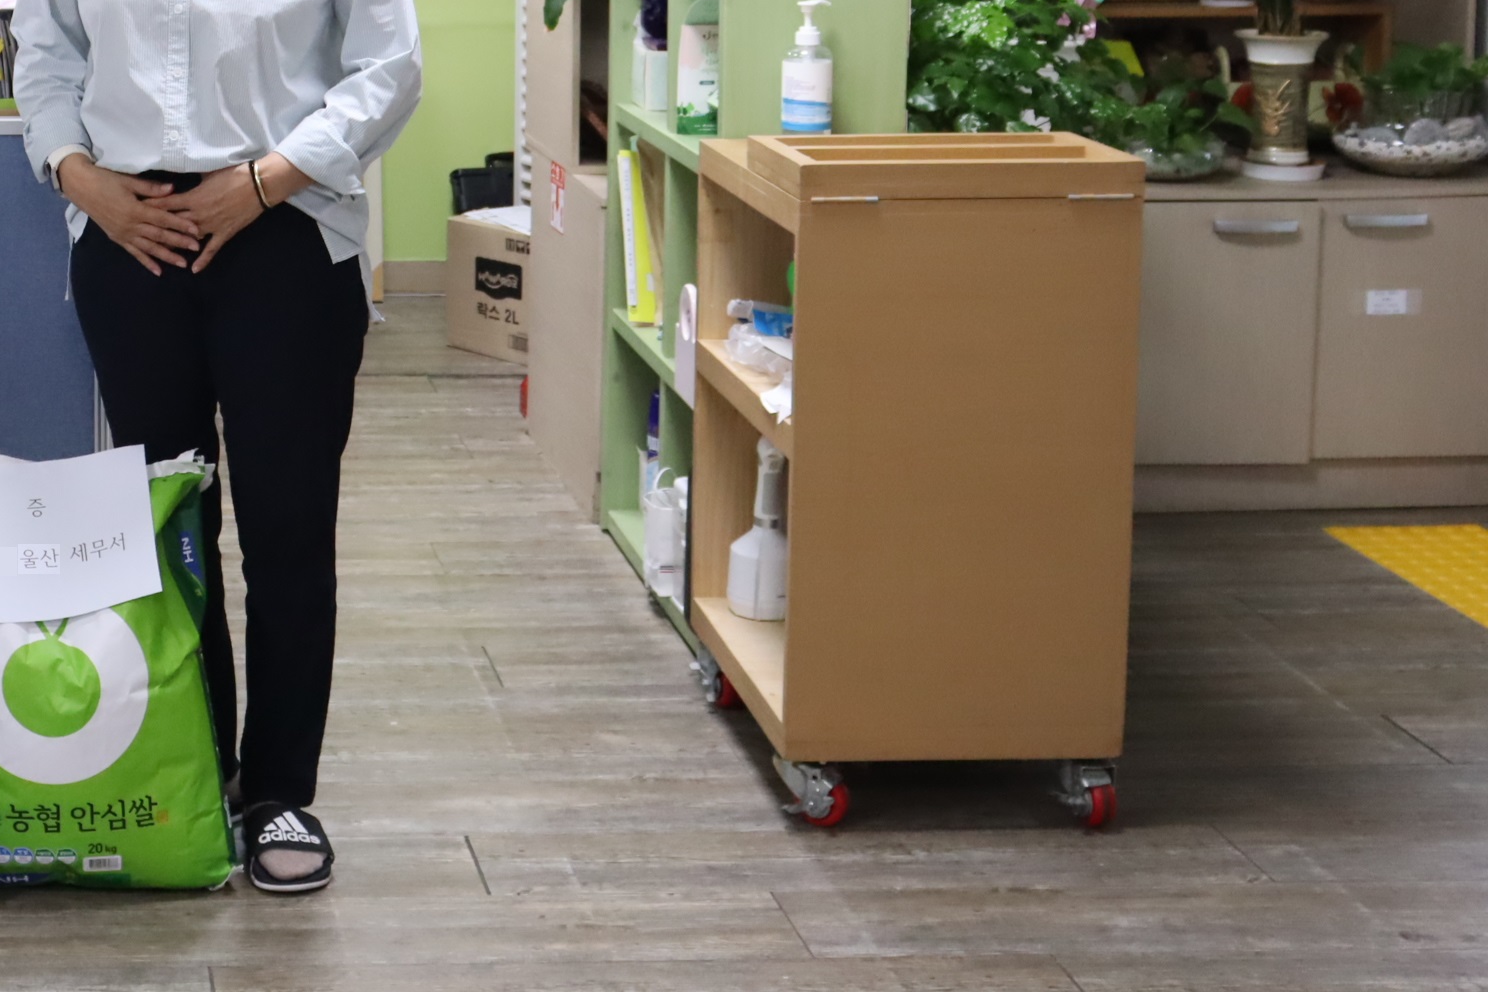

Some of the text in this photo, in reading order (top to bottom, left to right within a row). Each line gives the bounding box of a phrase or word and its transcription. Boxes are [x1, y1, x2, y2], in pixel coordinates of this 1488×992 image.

[504, 309, 520, 326] 2L
[27, 498, 46, 518] 증
[20, 532, 126, 569] 울산 세무서
[5, 803, 61, 833] 농협
[70, 795, 158, 833] 안심쌀
[258, 828, 321, 845] adidas
[88, 843, 117, 854] 20 kg
